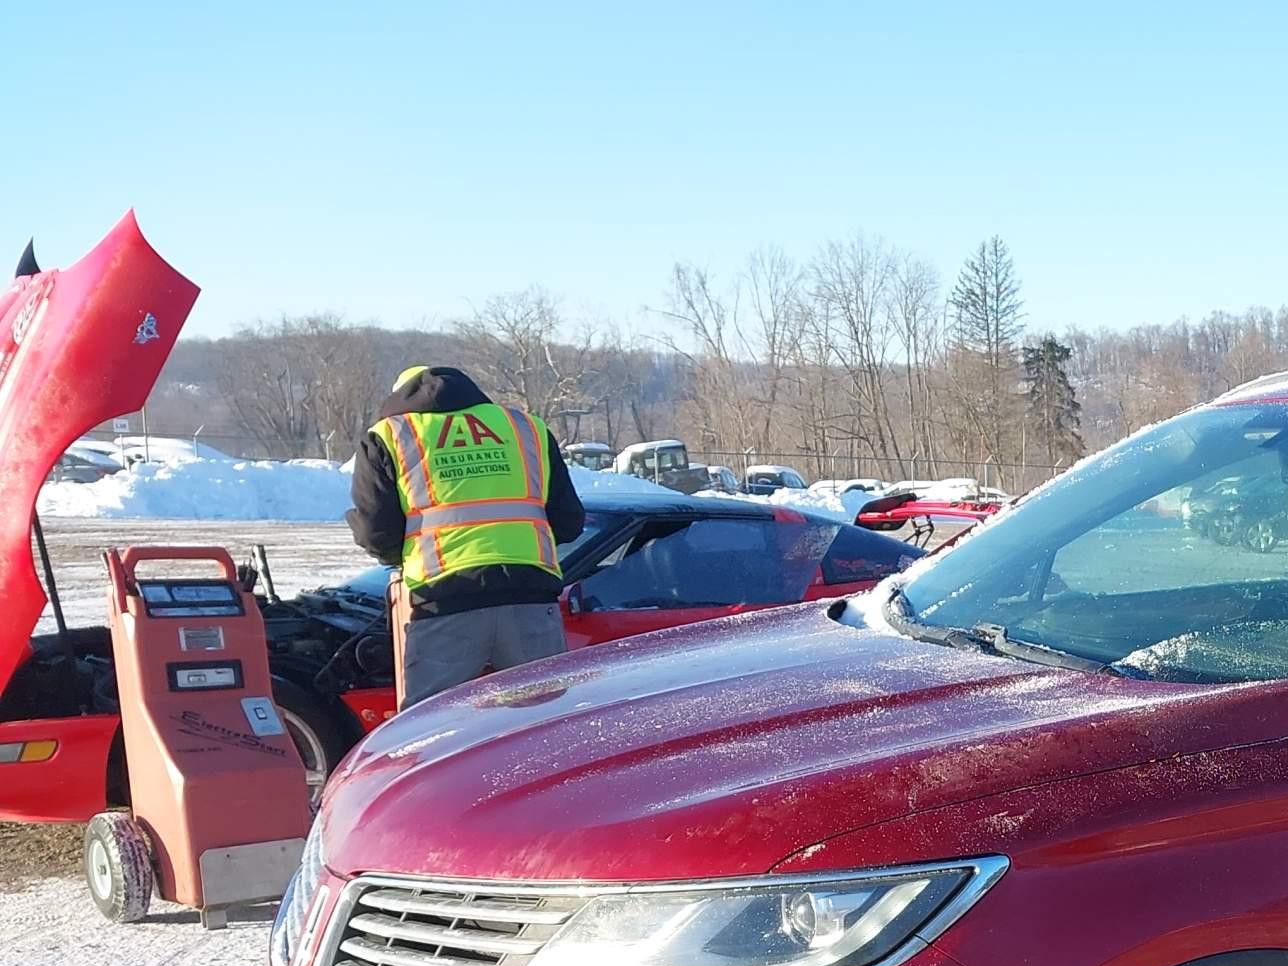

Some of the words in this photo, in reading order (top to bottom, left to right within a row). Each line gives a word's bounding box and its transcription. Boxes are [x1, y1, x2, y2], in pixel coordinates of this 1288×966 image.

[434, 451, 508, 466] INSURANCE
[439, 468, 464, 479] AUTO
[465, 463, 511, 475] AUCTIONS
